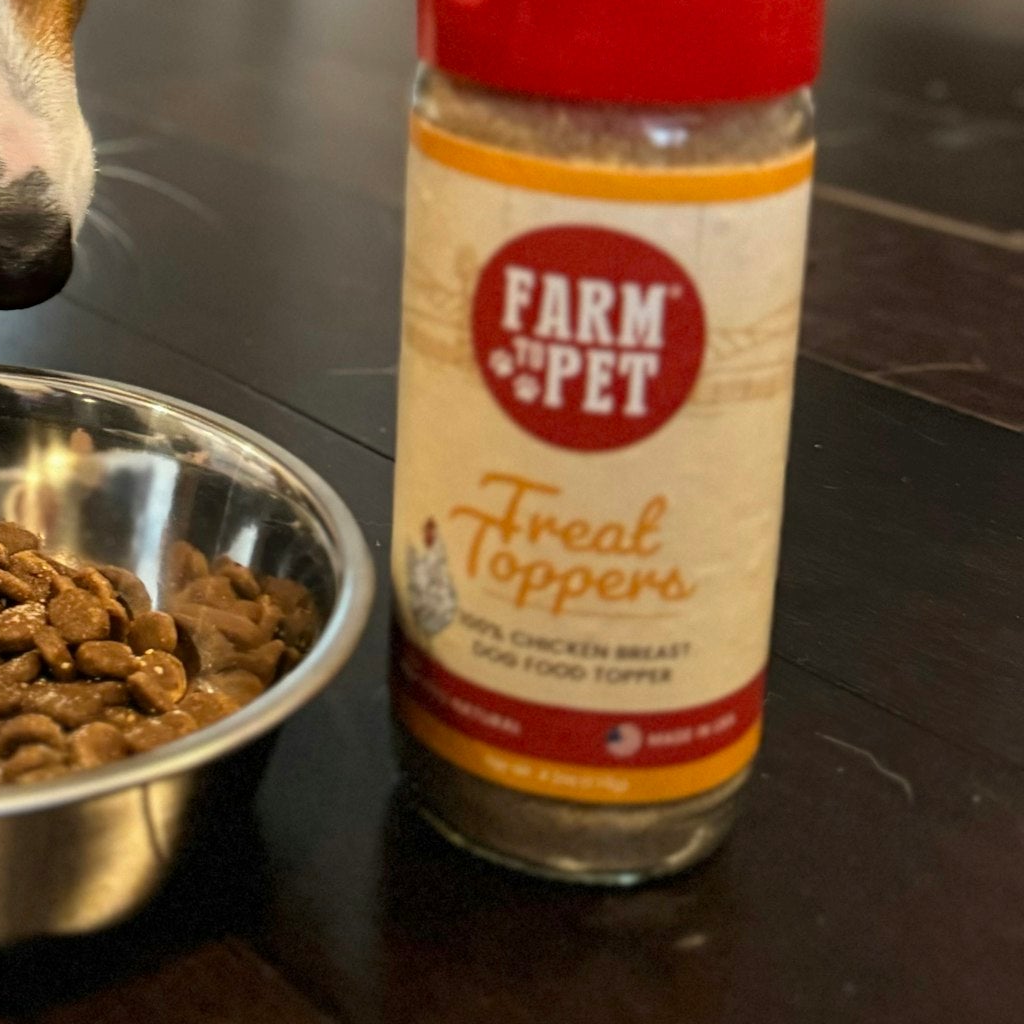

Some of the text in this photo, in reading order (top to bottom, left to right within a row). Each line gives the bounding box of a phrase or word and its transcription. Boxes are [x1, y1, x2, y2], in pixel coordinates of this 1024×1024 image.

[502, 265, 666, 347] FARM
[544, 345, 659, 417] PET
[480, 472, 668, 556] Treat
[449, 505, 696, 616] Toppers
[472, 640, 673, 684] DOG FOOD TOPPER
[510, 630, 609, 658] CHICKEN
[614, 642, 691, 661] BREAST
